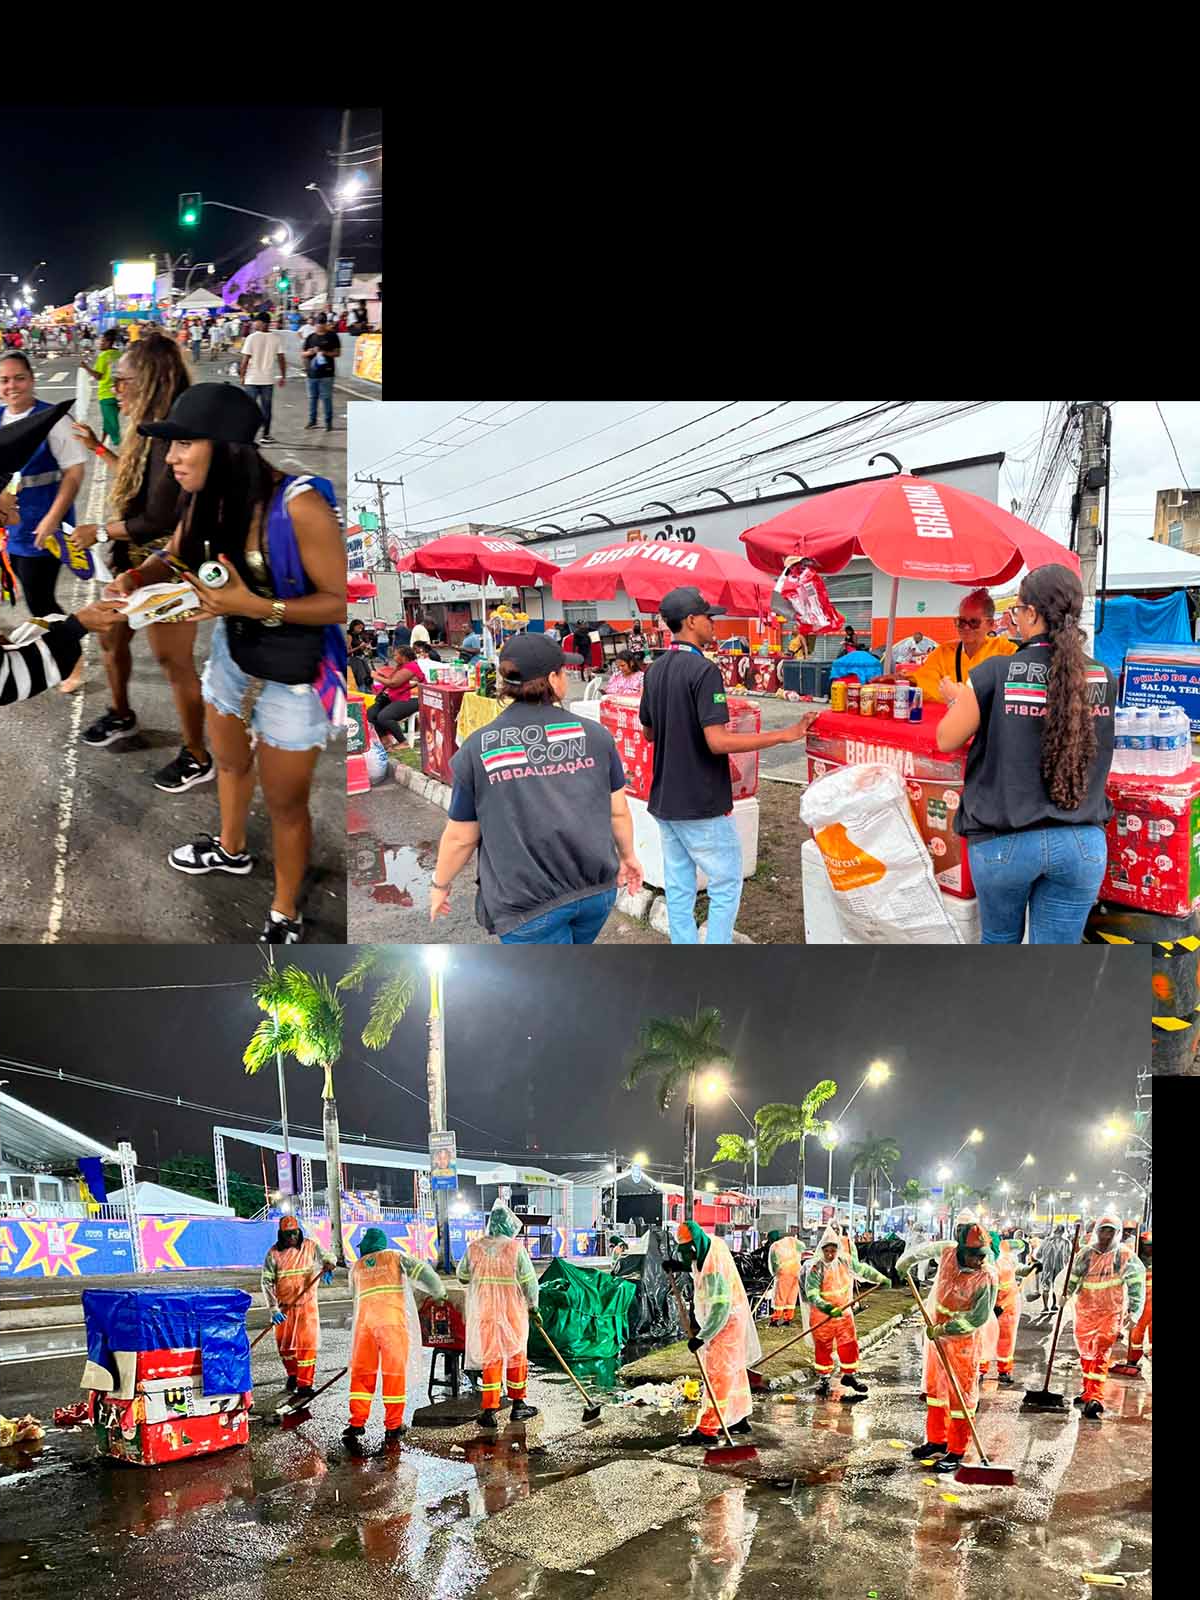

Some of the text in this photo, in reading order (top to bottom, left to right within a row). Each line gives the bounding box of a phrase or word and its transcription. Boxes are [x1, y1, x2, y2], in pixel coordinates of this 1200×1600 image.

[901, 485, 954, 539] BRAHMA
[582, 542, 701, 572] BRAHMA
[1007, 661, 1053, 683] PR
[1140, 683, 1160, 692] SAL
[1161, 684, 1177, 693] DA
[481, 724, 543, 752] PRO
[526, 735, 587, 765] CON
[488, 756, 596, 785] FISCALIZAÇÃO
[845, 739, 916, 777] BRAHMA
